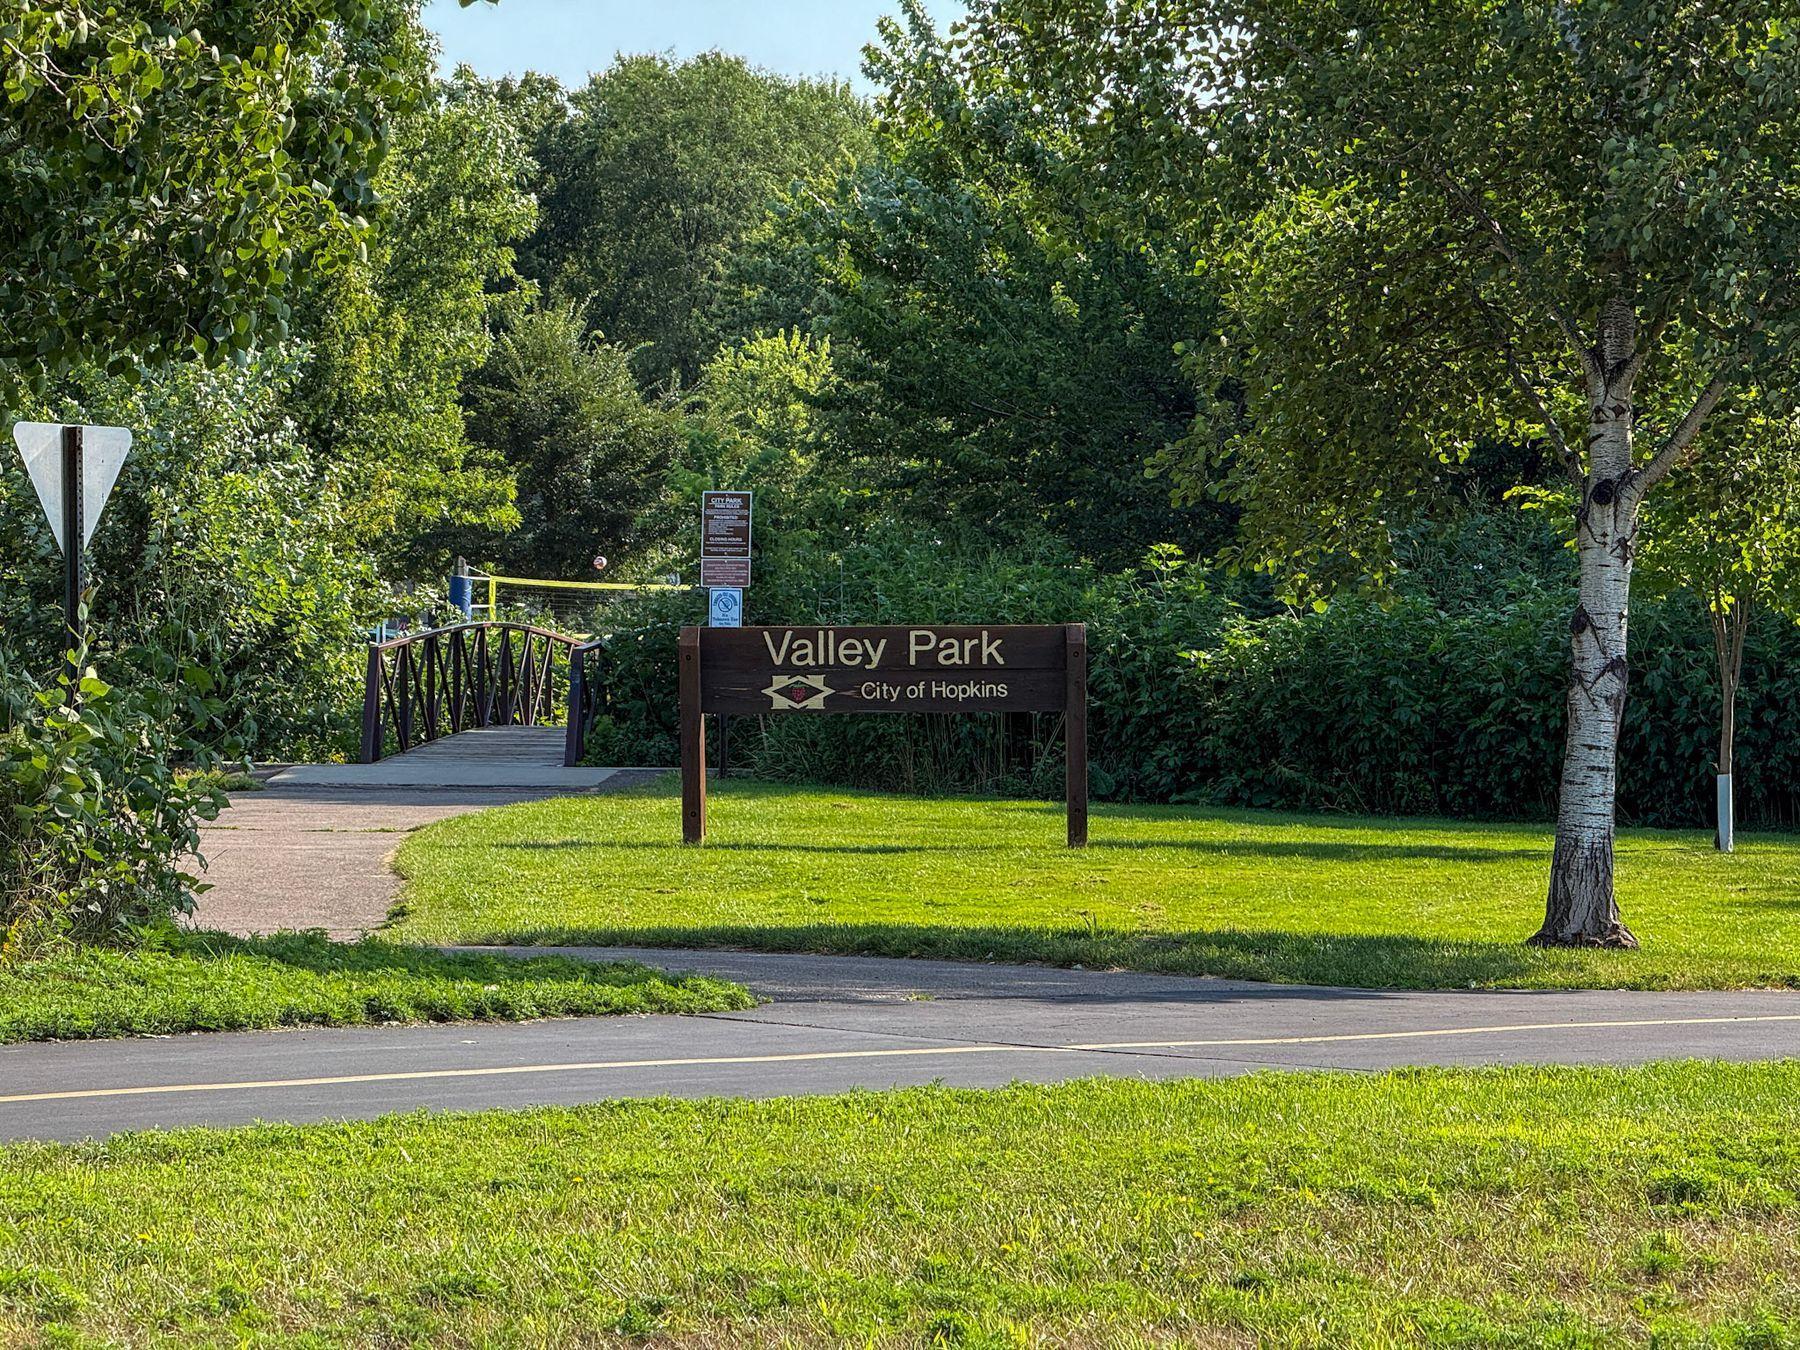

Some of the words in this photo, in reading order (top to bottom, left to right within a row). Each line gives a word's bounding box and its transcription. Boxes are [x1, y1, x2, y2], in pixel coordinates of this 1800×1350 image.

[763, 630, 887, 669] Valley
[909, 630, 1005, 665] Park
[861, 682, 900, 701] City
[906, 681, 926, 699] of
[931, 681, 1008, 701] Hopkins
